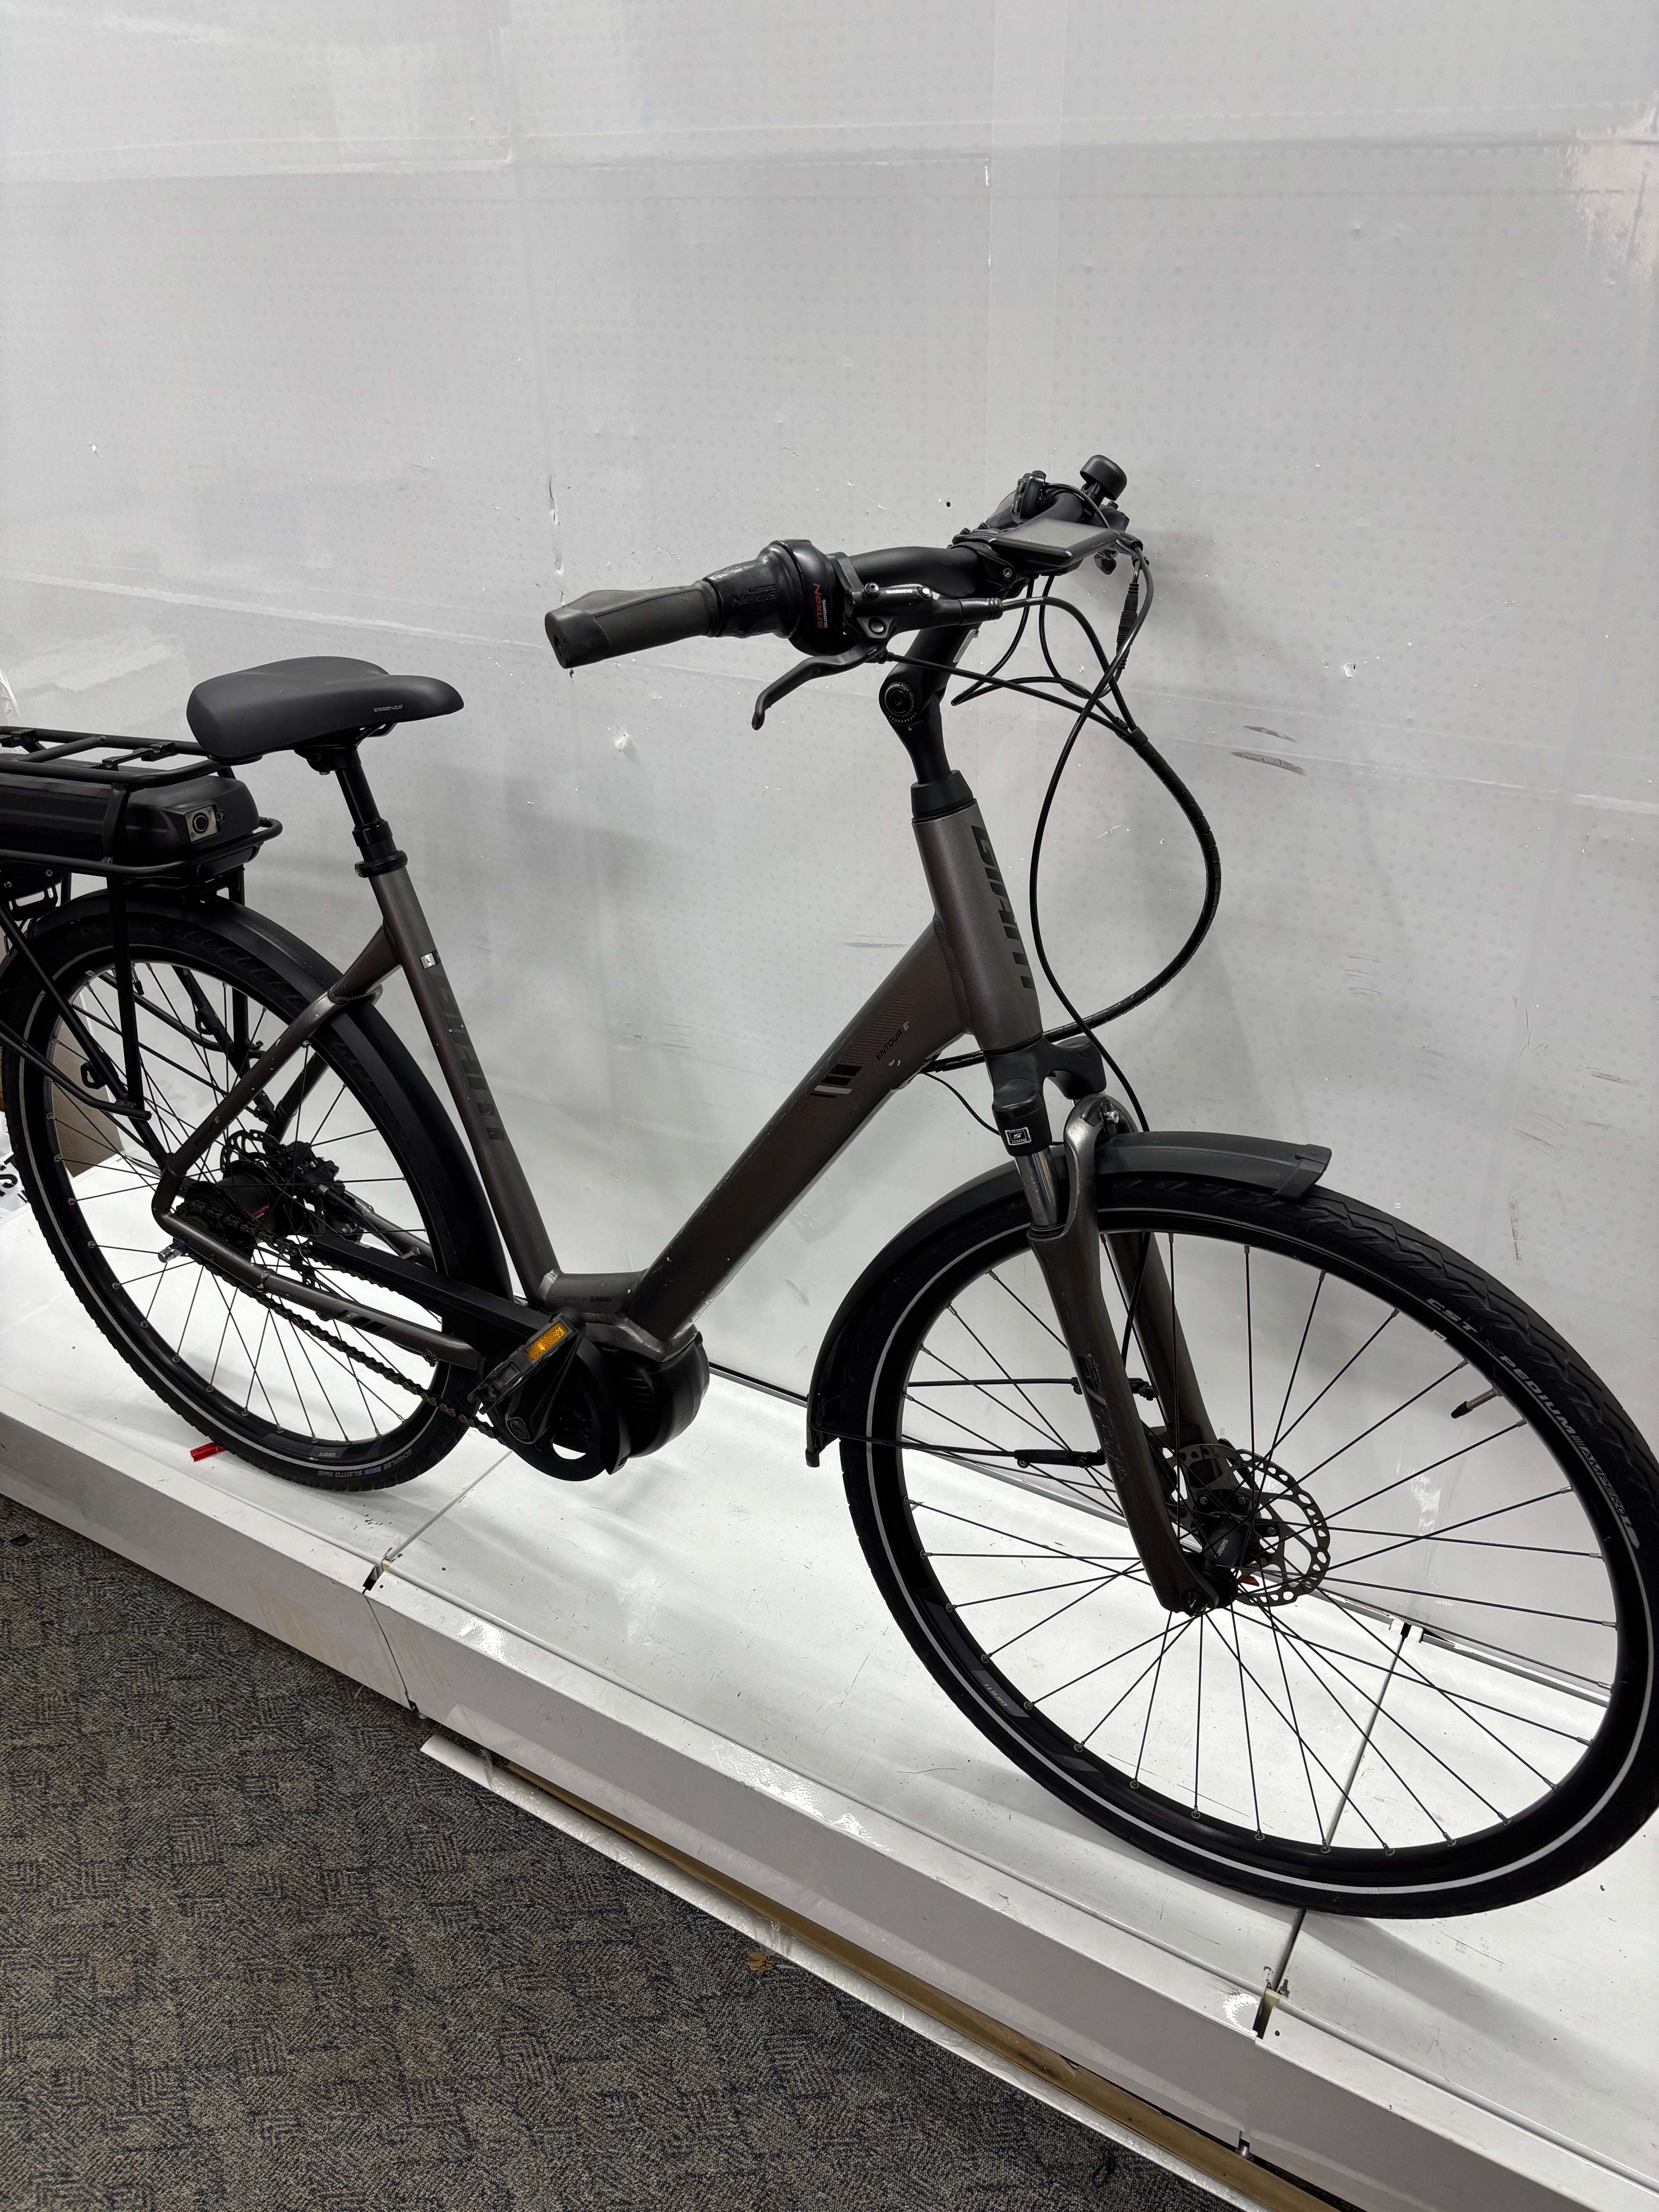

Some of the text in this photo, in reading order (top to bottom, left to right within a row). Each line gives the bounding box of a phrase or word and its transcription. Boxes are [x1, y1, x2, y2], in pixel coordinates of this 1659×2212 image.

[747, 584, 776, 595] SHIMANO
[876, 1029, 903, 1061] ENTOUR
[1426, 1298, 1478, 1333] CST
[383, 1448, 413, 1470] SCHWALBE
[334, 1470, 363, 1478] SILENTO
[984, 1684, 1008, 1707] GIANT
